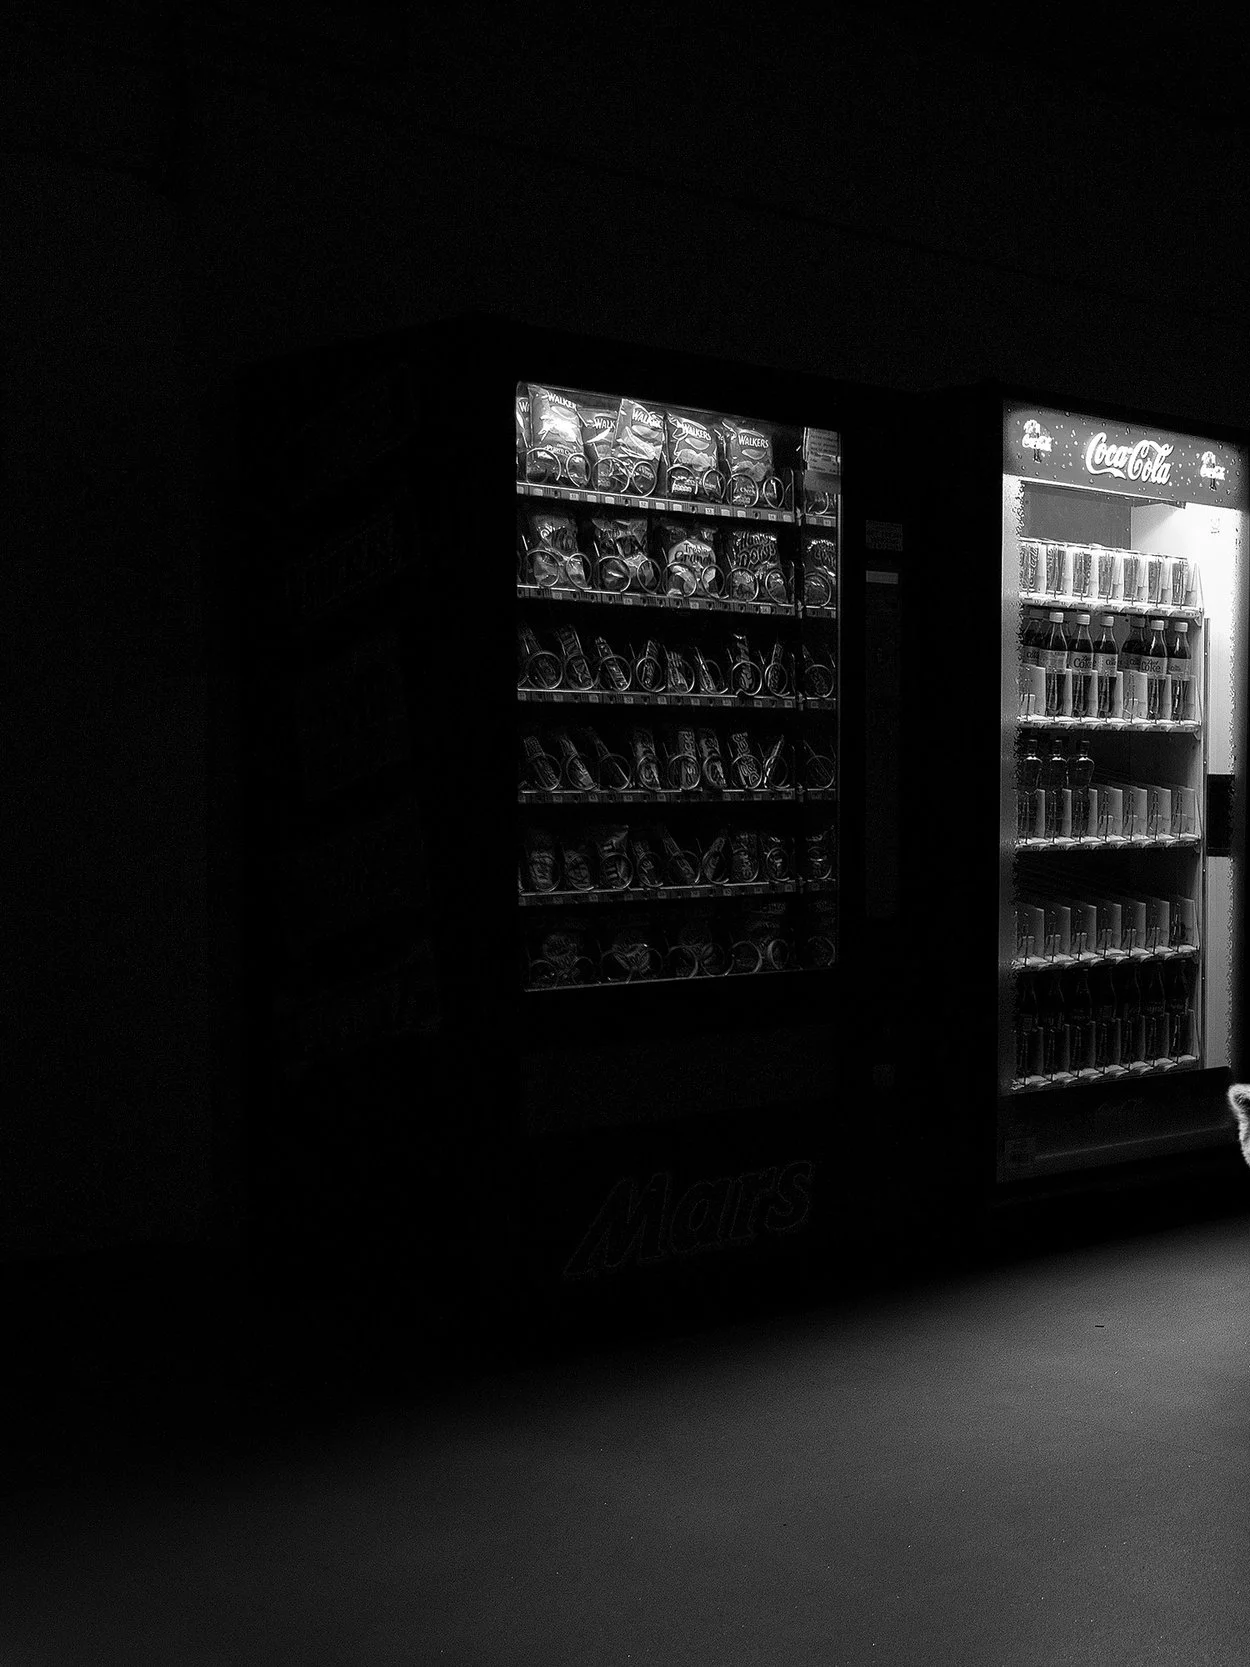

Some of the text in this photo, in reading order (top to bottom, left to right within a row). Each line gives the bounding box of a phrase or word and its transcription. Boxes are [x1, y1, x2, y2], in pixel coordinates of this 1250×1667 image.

[548, 393, 577, 409] WALKER
[594, 417, 616, 430] WALK
[682, 421, 712, 441] WALKERS
[738, 434, 769, 449] WALKERS
[1085, 432, 1174, 485] Coca-Cola
[562, 1160, 815, 1275] Mars
